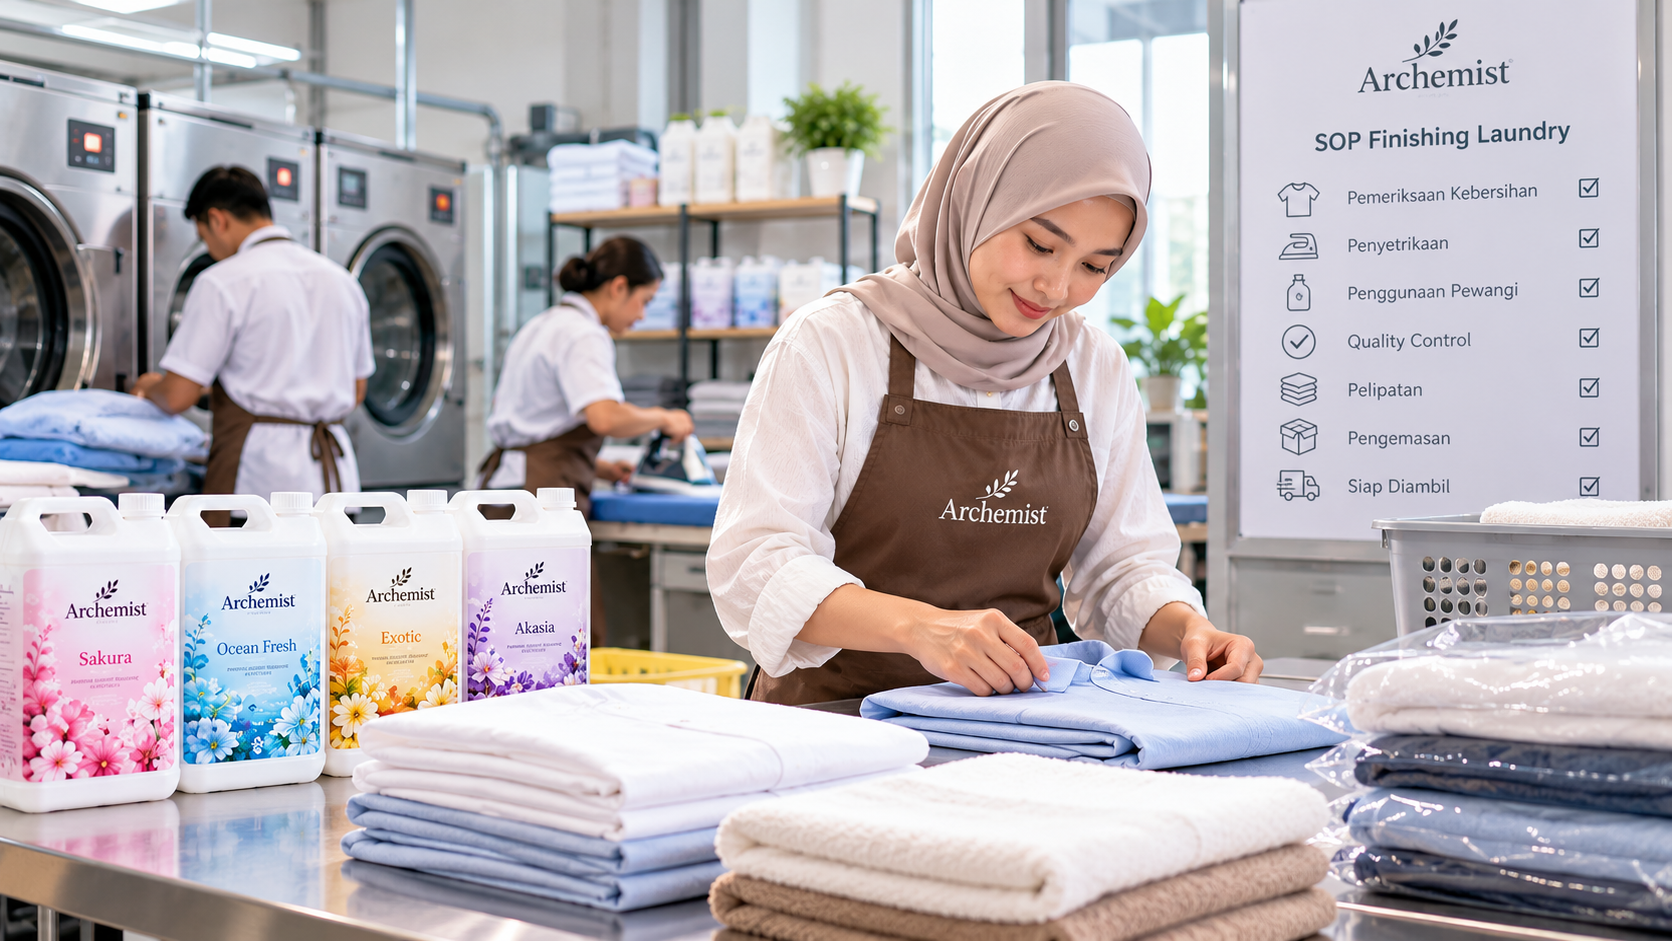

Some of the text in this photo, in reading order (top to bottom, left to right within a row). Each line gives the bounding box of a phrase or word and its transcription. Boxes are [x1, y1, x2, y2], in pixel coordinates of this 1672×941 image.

[1358, 59, 1510, 93] Archemist
[1314, 121, 1571, 152] SOP Finishing Laundry
[1347, 183, 1538, 205] Pemeriksaan Kebersihan
[1348, 236, 1449, 255] Penyetrikaan
[1348, 282, 1519, 304] Penggunaan Pewangi
[1347, 332, 1472, 351] Quality Control
[1348, 382, 1423, 400] Pelipatan
[1348, 430, 1451, 449] Pengemasan
[1348, 478, 1450, 497] Siap Diambil
[938, 498, 1048, 525] Archemist
[366, 586, 435, 603] Archemist
[501, 579, 567, 596] Archemist
[65, 601, 147, 619] Archemist
[221, 593, 296, 611] Archemist
[514, 620, 556, 635] Akasia
[381, 629, 422, 645] Exotic
[216, 639, 297, 656] Ocean Fresh
[79, 650, 133, 667] Sakura
